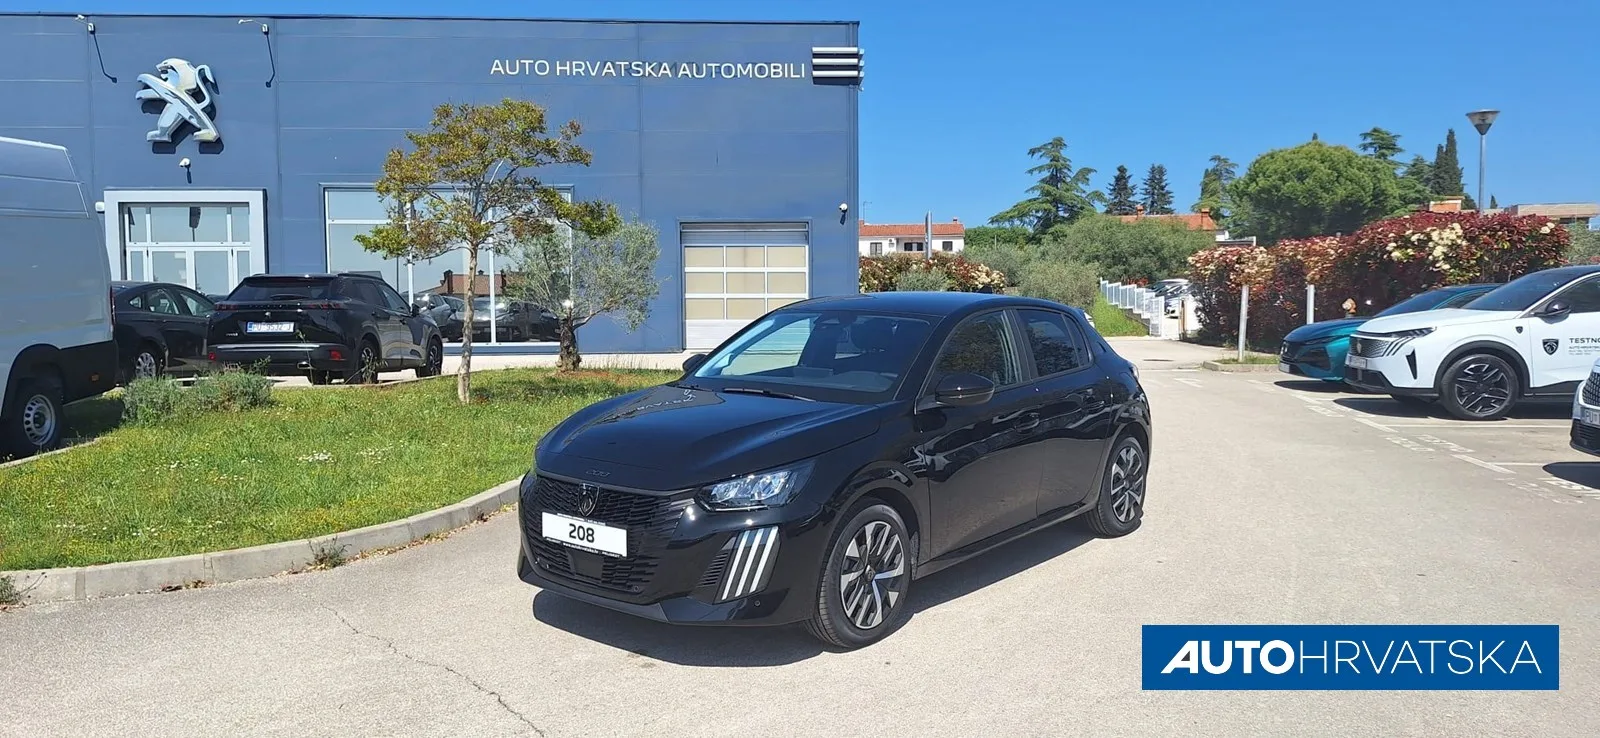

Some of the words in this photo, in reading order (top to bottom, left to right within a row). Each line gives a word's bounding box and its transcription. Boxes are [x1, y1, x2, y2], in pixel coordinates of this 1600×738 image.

[490, 59, 550, 76] AUTO
[556, 60, 672, 78] HRVATSKA
[678, 62, 806, 79] AUTOMOBILI
[568, 523, 595, 543] 208
